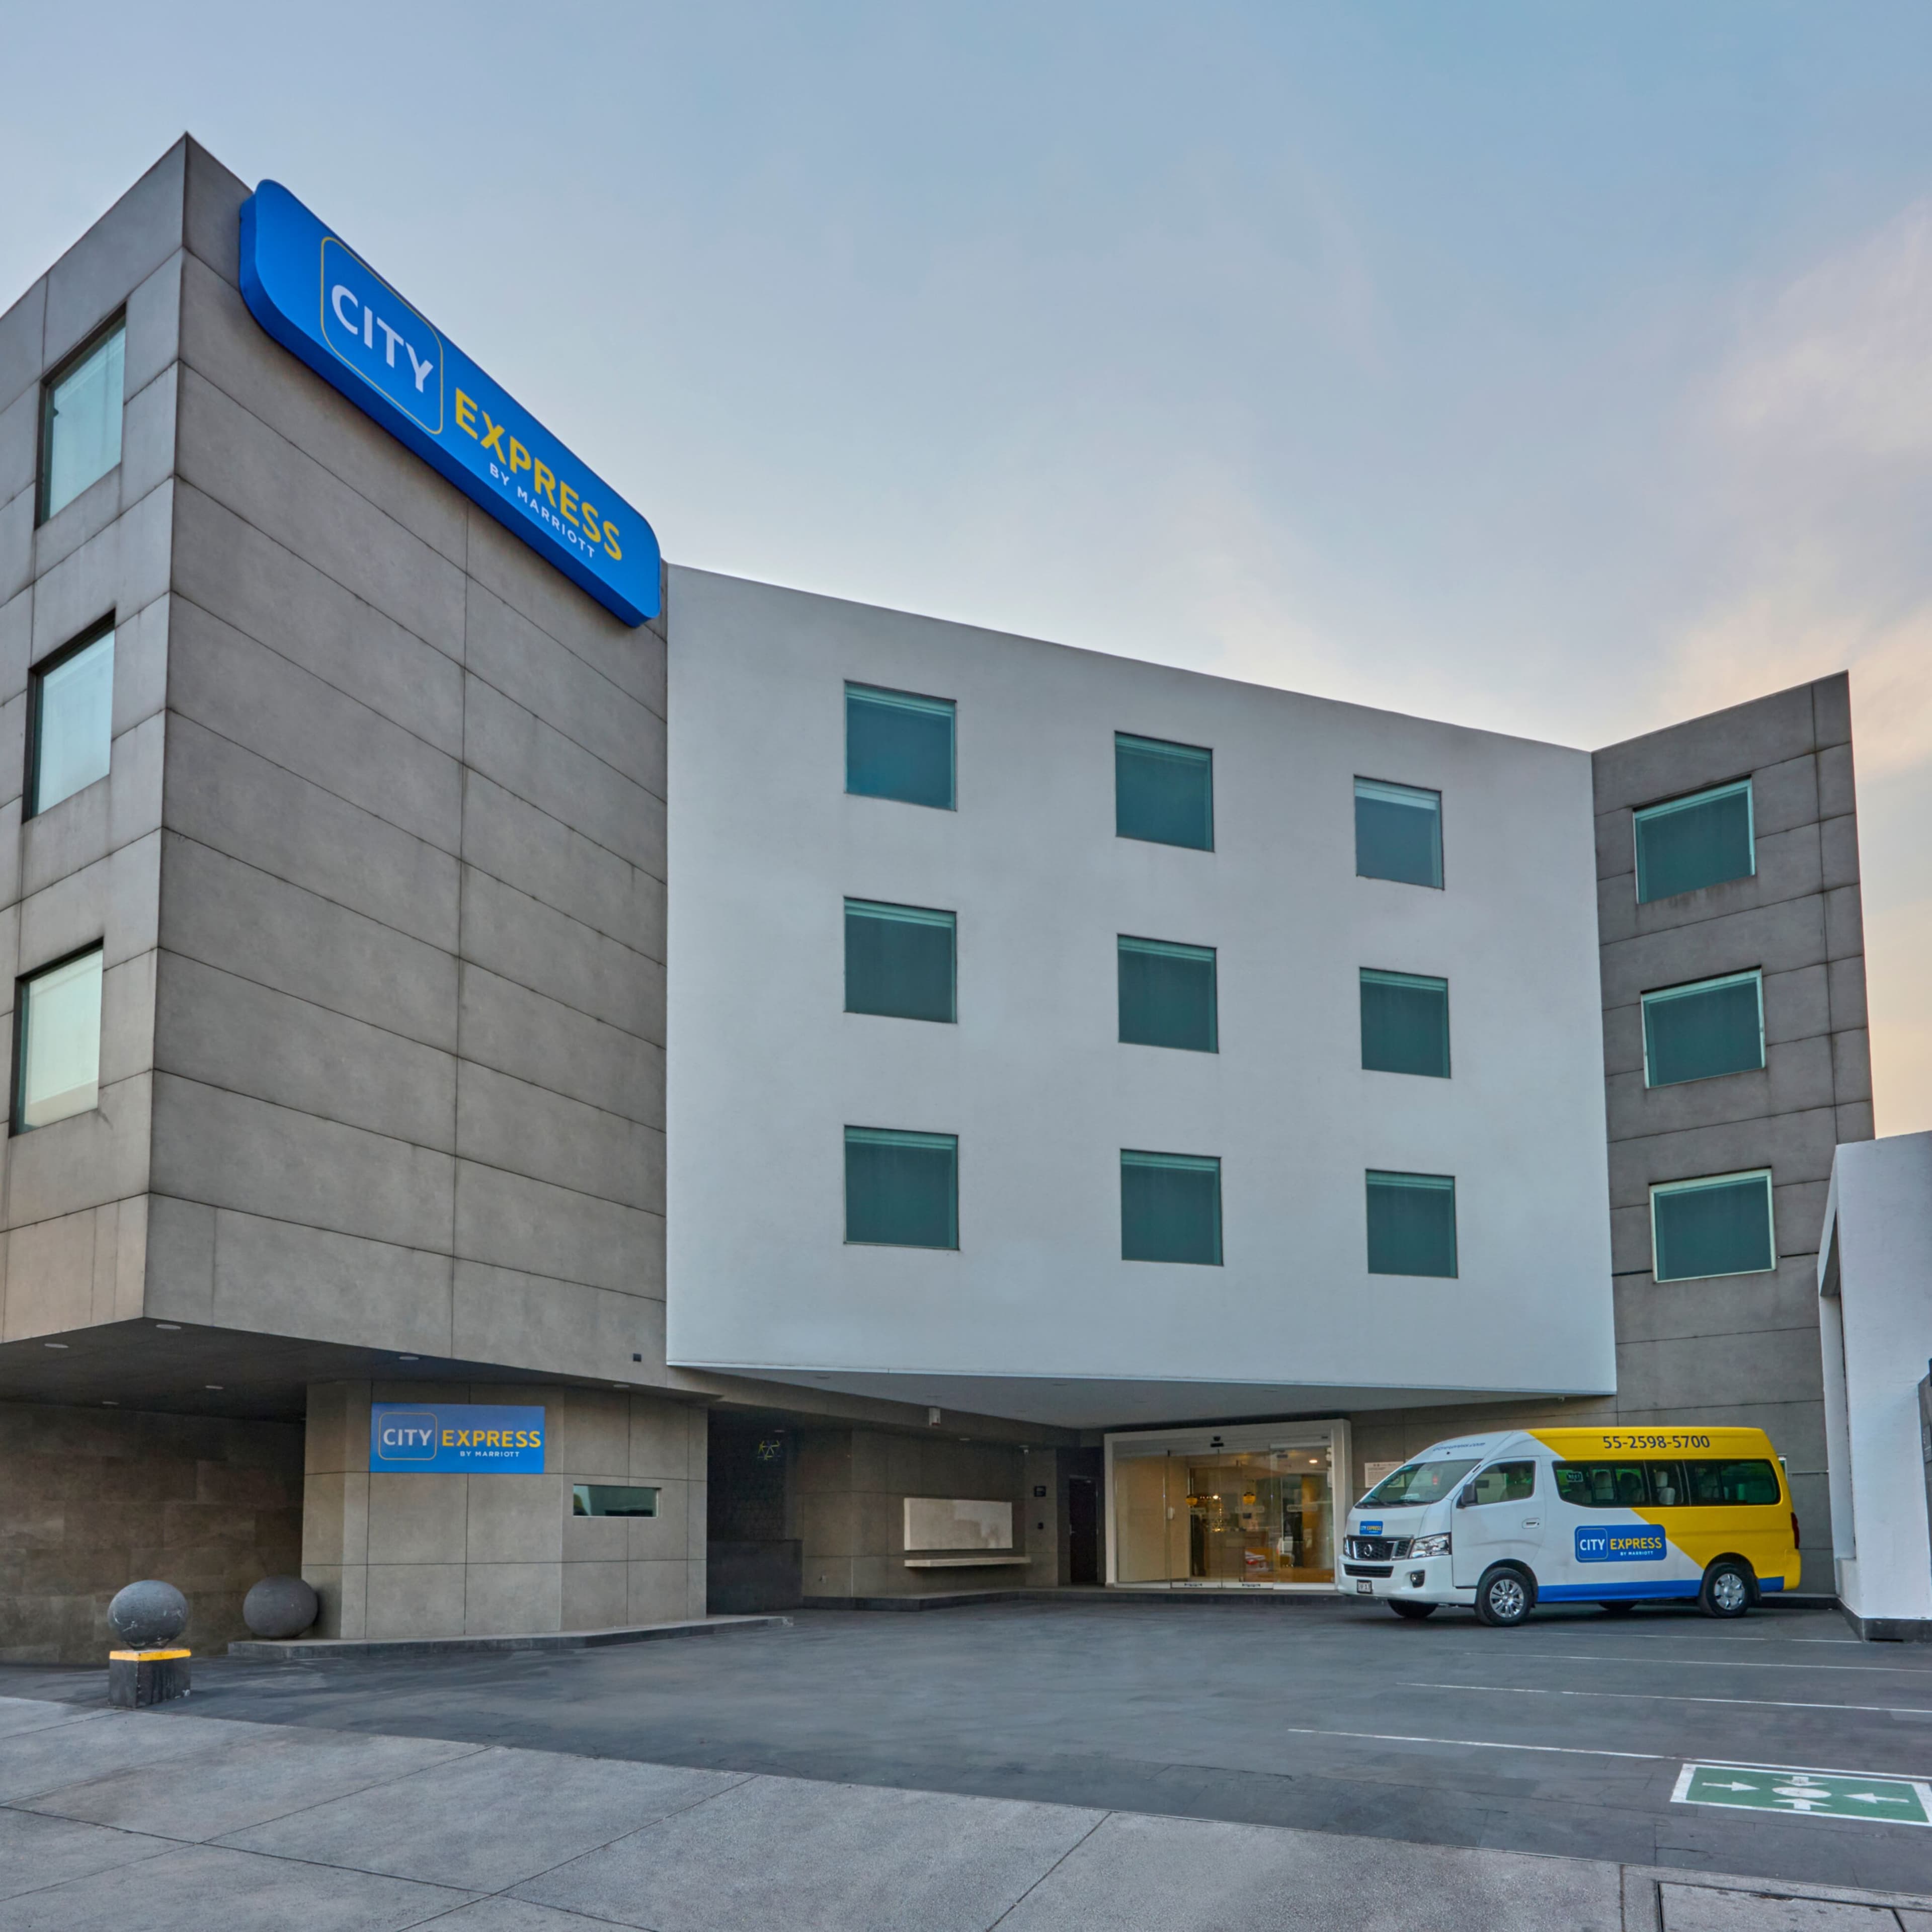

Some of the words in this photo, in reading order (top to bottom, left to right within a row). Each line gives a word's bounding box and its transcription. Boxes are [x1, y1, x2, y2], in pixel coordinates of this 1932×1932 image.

[331, 284, 434, 393] CITY
[455, 387, 622, 560] EXPRESS
[490, 462, 510, 486] BY
[517, 486, 595, 558] MARRIOTT
[383, 1428, 433, 1446] CITY
[442, 1430, 541, 1448] EXPRESS
[1602, 1435, 1710, 1448] 55-2598-5700
[1579, 1539, 1605, 1551] CITY
[1610, 1537, 1662, 1550] EXPRESS
